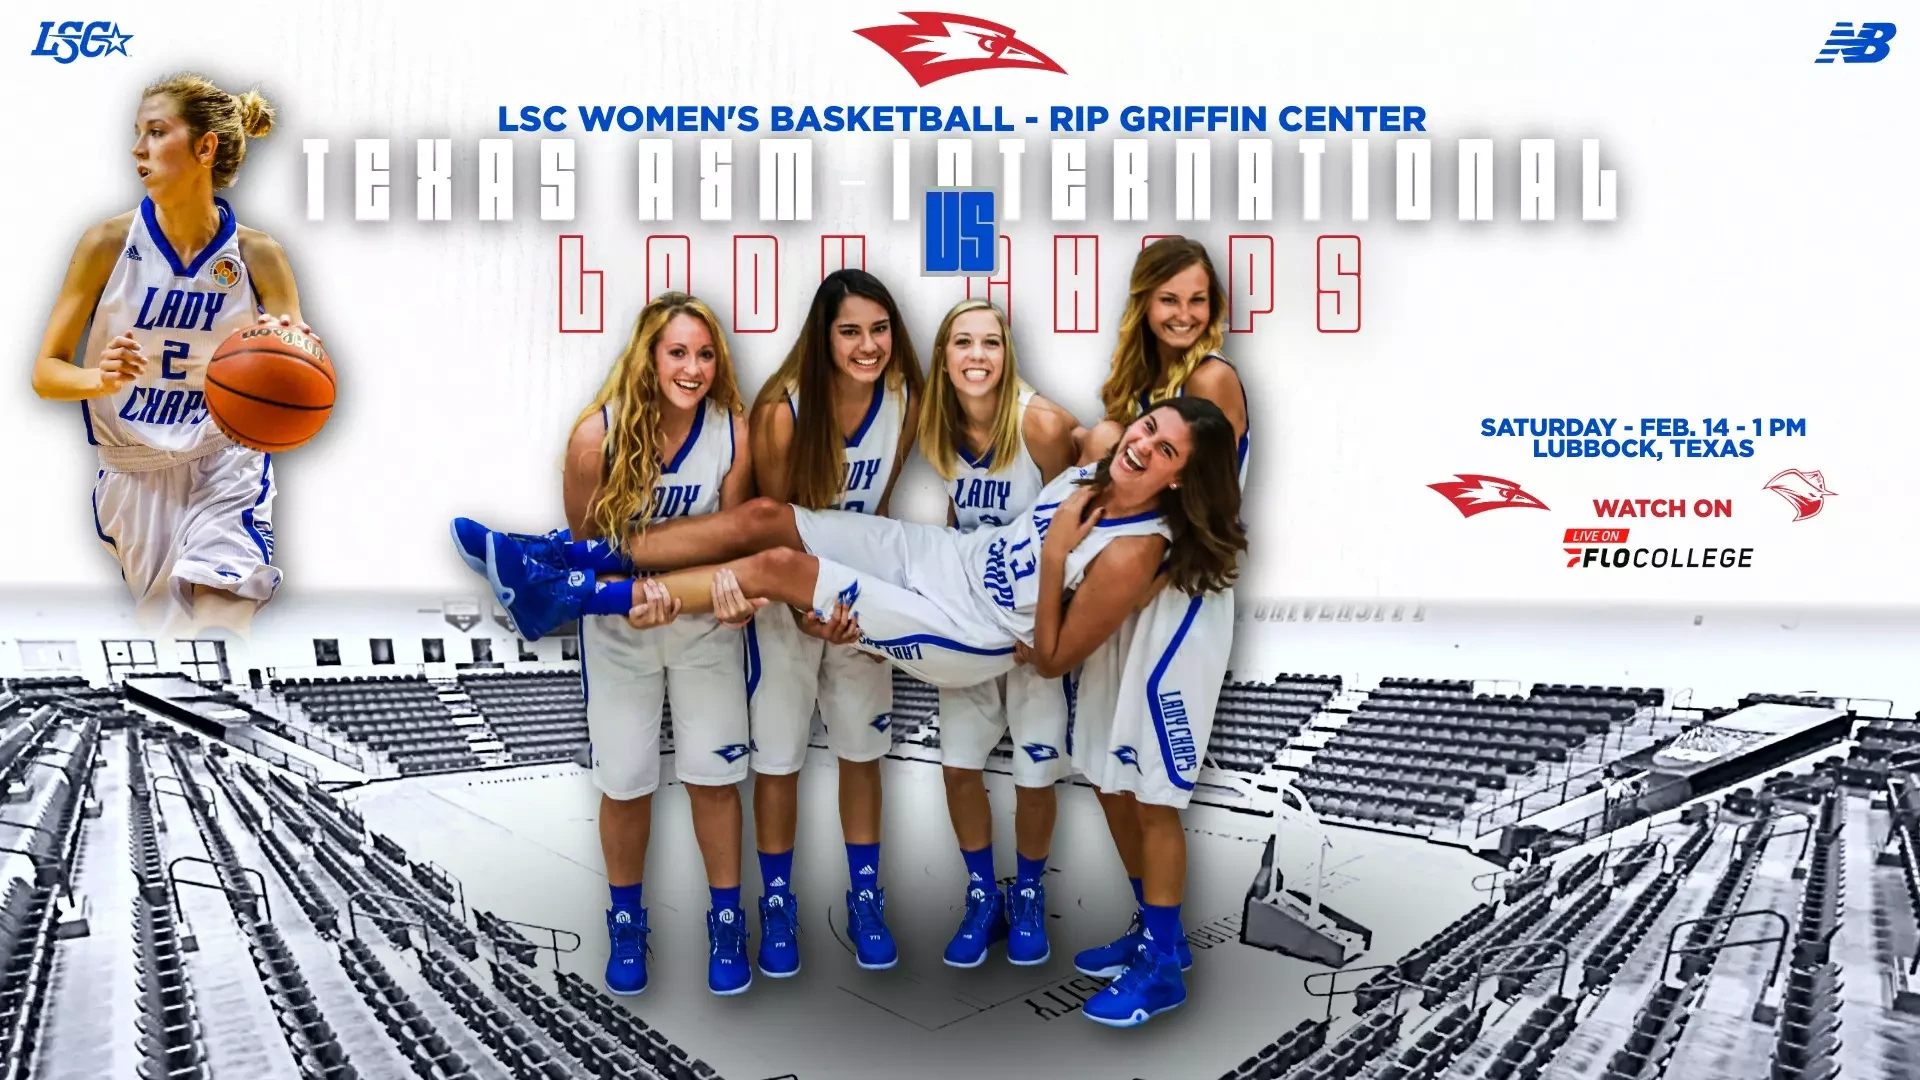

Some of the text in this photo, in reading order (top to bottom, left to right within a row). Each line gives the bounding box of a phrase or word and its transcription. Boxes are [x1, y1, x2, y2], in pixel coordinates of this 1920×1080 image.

[133, 287, 228, 332] LADY
[161, 340, 190, 380] 2
[630, 484, 702, 521] ADY
[954, 478, 1011, 511] LADY
[984, 537, 1017, 611] CHAPS
[1009, 537, 1037, 582] 13
[1159, 691, 1198, 772] LADY CHAPS
